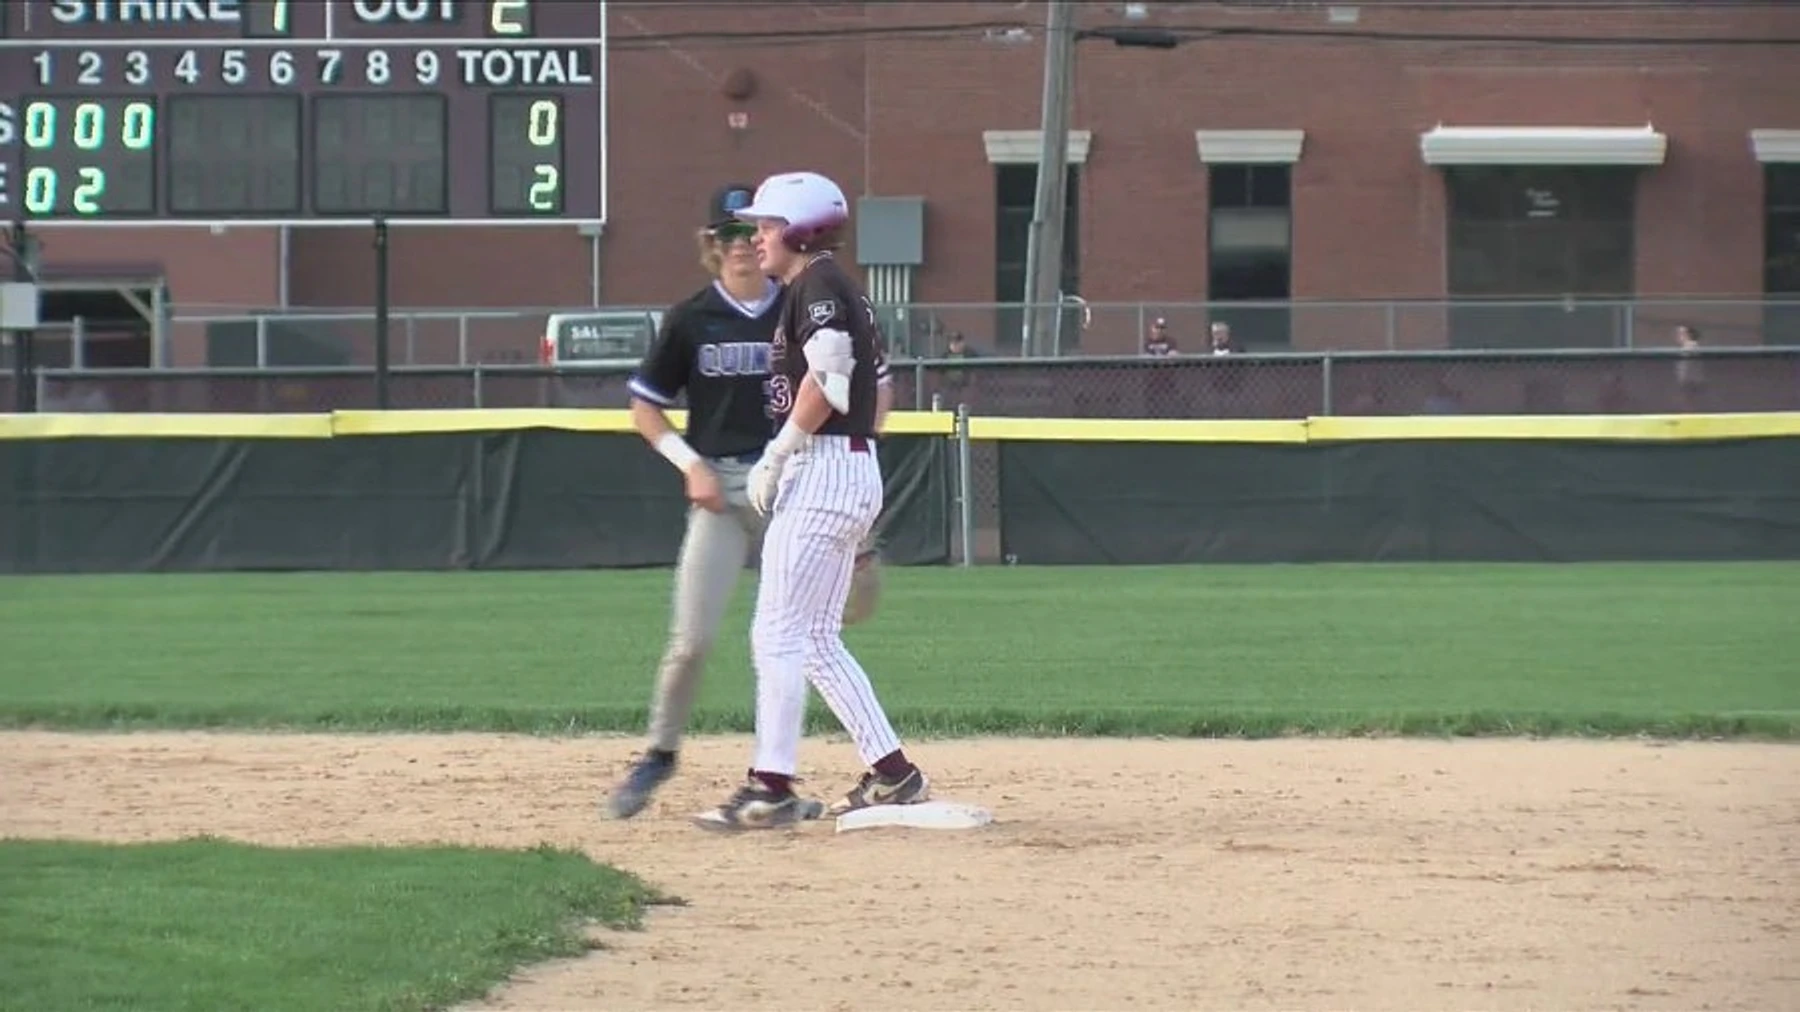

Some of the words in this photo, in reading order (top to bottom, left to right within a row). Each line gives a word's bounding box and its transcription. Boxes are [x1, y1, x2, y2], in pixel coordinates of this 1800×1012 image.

[33, 51, 51, 84] 1
[77, 51, 102, 84] 2
[125, 51, 149, 84] 3
[174, 51, 198, 84] 4
[222, 51, 246, 84] 5
[269, 51, 294, 84] 6
[317, 50, 341, 83] 7
[366, 50, 390, 83] 8
[415, 50, 439, 83] 9
[456, 50, 593, 84] TOTAL
[528, 101, 557, 146] 0
[529, 164, 558, 209] 2
